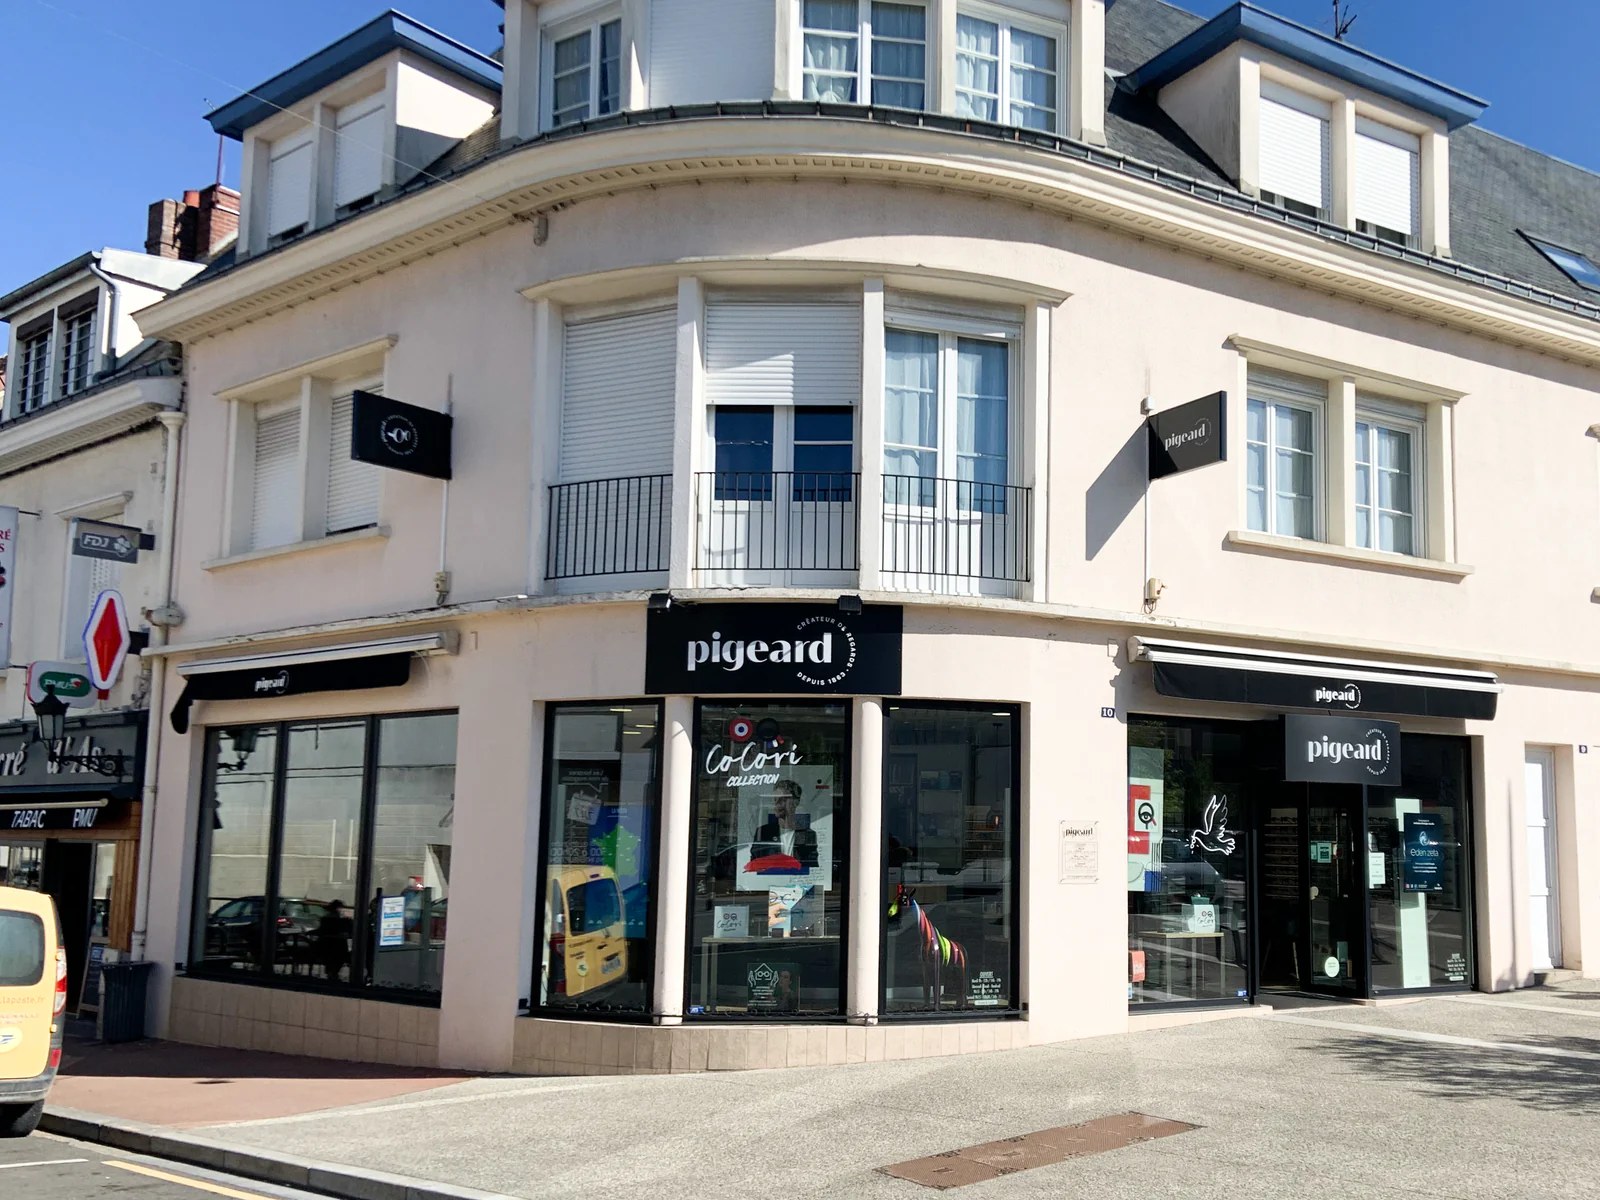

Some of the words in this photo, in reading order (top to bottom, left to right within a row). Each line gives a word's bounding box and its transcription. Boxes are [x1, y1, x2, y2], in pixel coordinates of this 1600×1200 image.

[1165, 424, 1206, 451] pigeard
[83, 535, 110, 548] FDJ
[797, 616, 836, 630] CRÉATEUR
[837, 622, 847, 632] DE
[846, 632, 857, 668] REGARDS
[687, 631, 832, 672] pigeard
[254, 675, 286, 692] pigeard
[797, 671, 826, 686] DEPUIS
[1315, 686, 1356, 703] pigeard
[1103, 708, 1113, 717] 10
[1308, 735, 1382, 764] pigeard
[726, 774, 780, 787] COLLECTION
[11, 810, 46, 829] TABAC
[73, 808, 98, 828] PMU
[1410, 848, 1427, 857] eden
